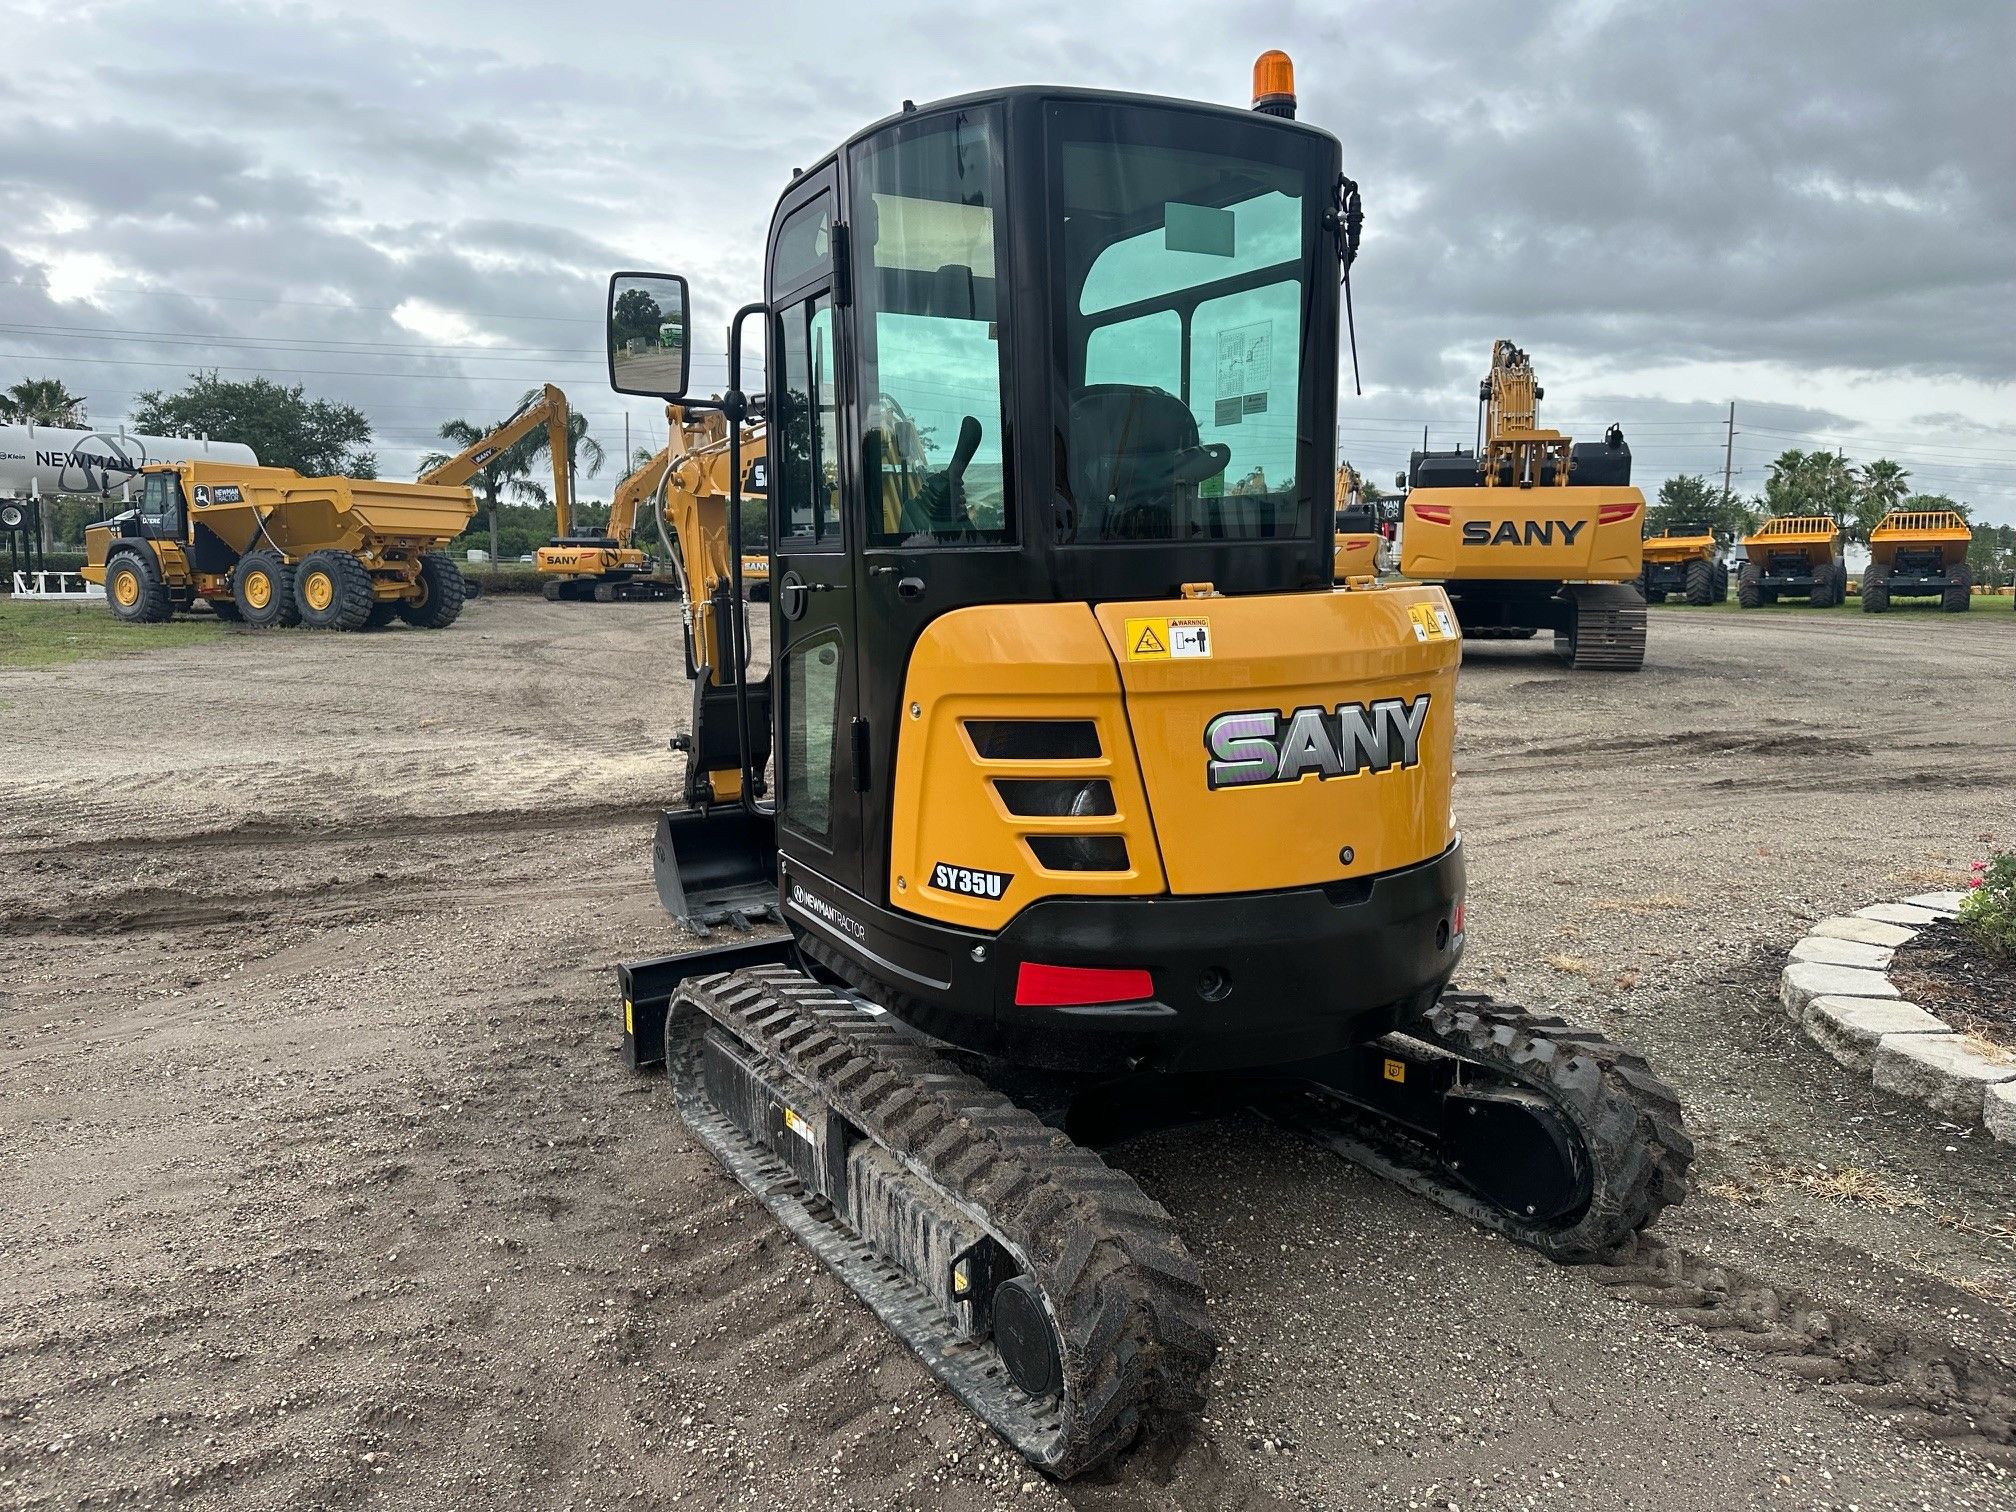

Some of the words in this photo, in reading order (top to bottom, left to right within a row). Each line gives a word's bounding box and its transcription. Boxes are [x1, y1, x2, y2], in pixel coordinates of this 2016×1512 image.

[475, 449, 493, 463] SANY
[214, 488, 239, 496] NEWMAN
[1462, 520, 1588, 546] SANY
[546, 556, 578, 565] SANY
[1203, 694, 1431, 791] SANY
[936, 864, 1001, 897] SY35U
